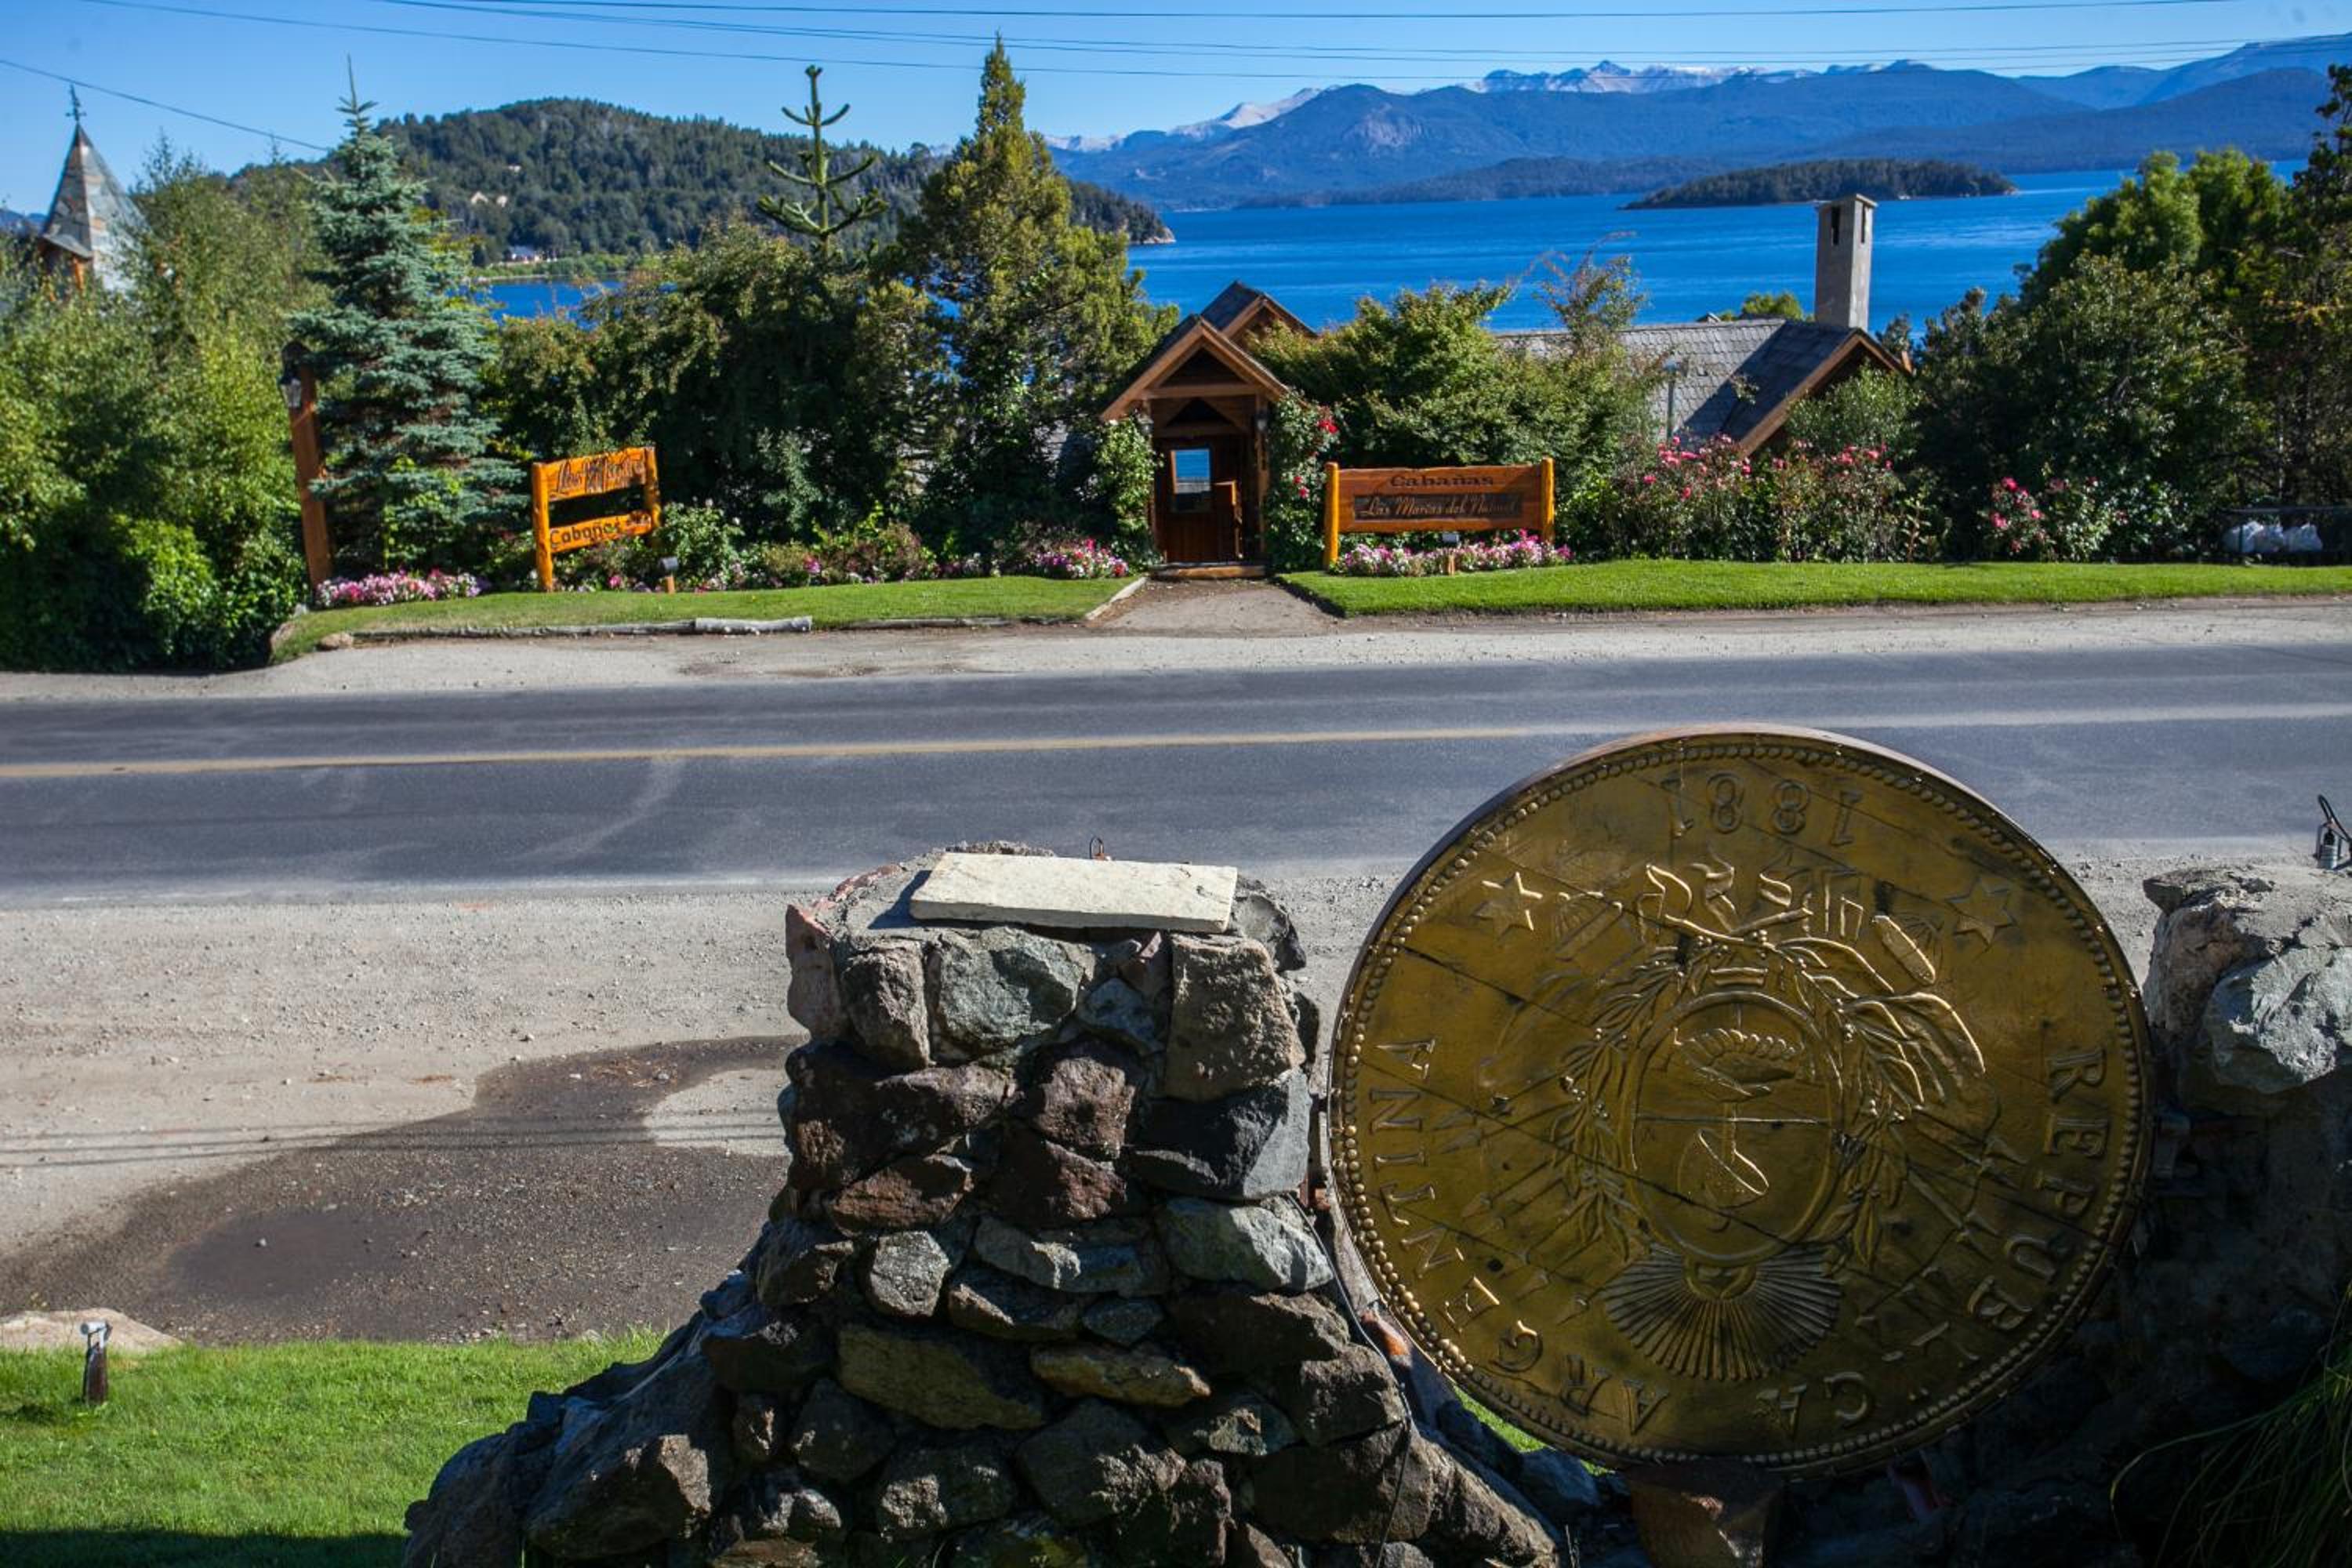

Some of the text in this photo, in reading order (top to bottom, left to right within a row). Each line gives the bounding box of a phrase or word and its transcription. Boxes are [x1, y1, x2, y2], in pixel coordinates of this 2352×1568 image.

[1390, 473, 1494, 487] Cabañas
[1660, 771, 1864, 846] 1881
[1369, 1037, 1668, 1435] ARGENTINA
